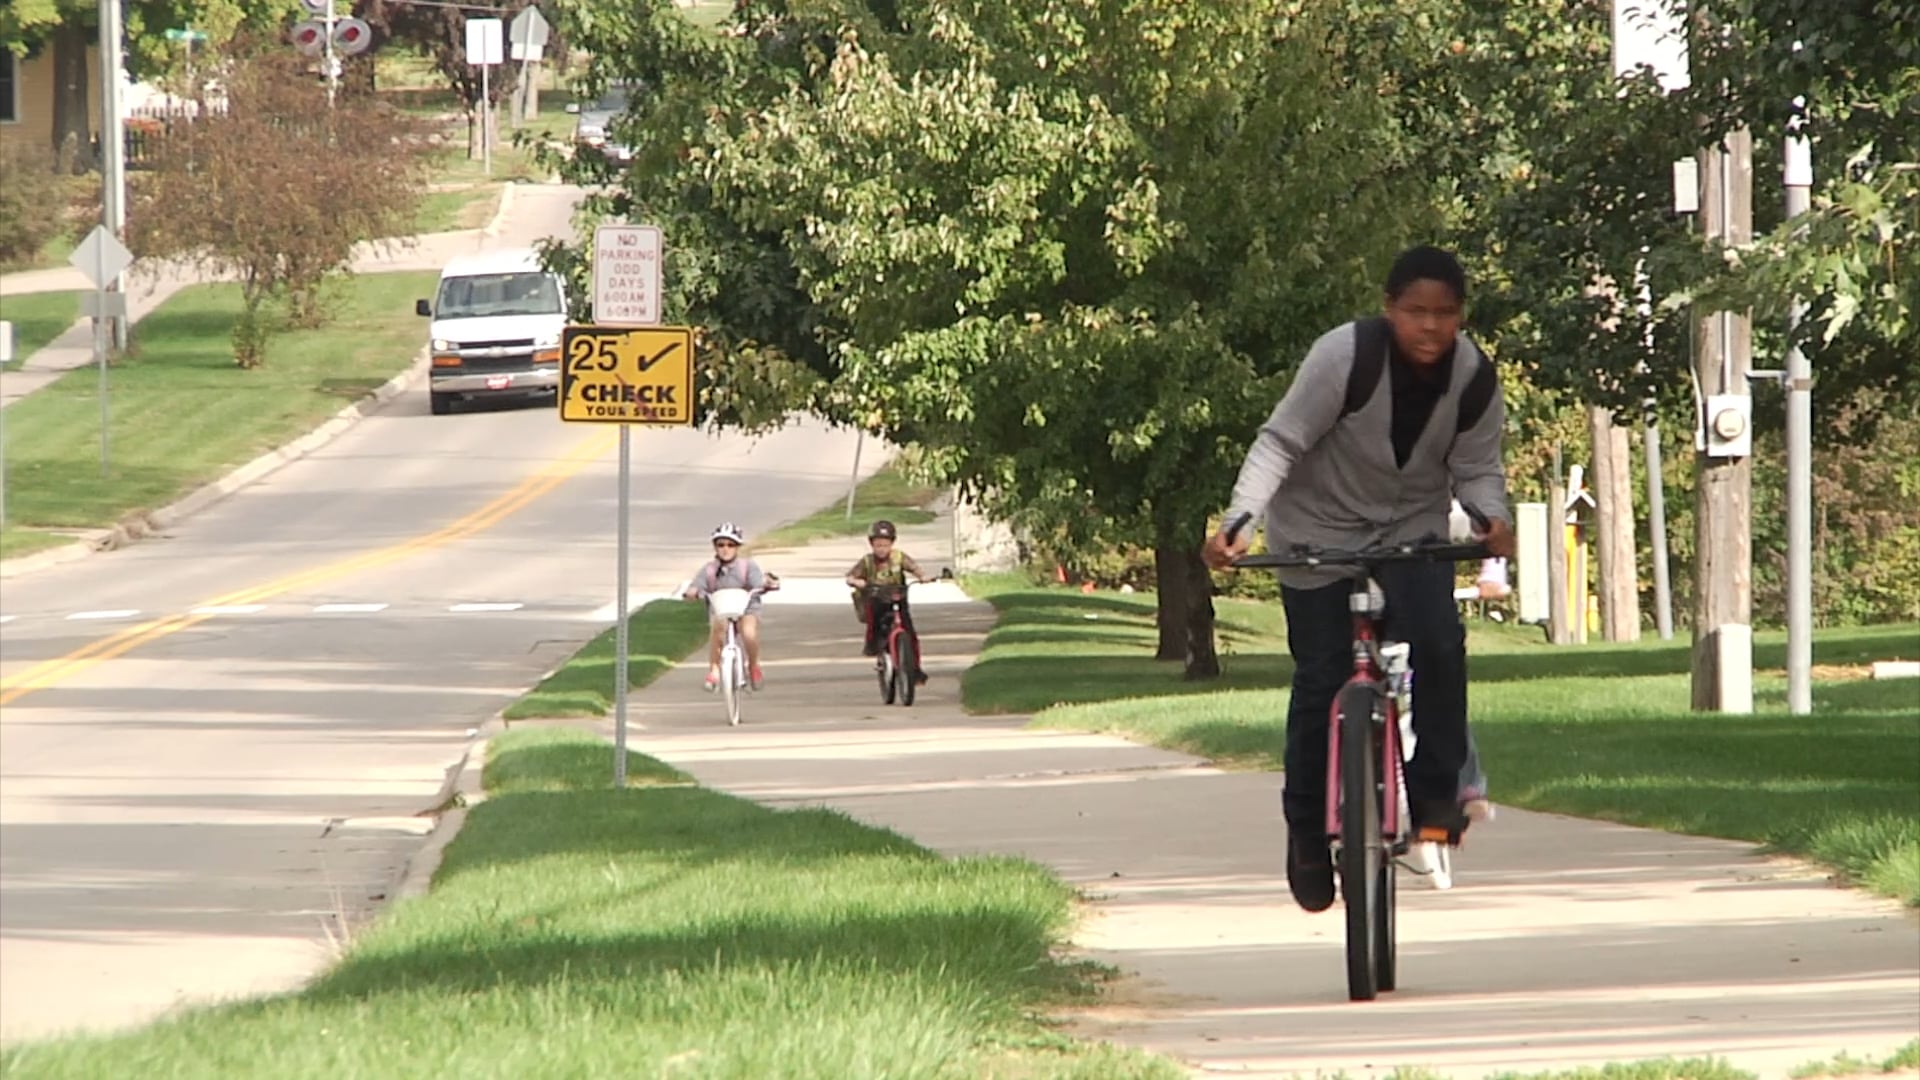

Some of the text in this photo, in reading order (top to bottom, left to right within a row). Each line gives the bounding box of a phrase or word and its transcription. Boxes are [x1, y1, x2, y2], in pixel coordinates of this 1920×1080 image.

[617, 234, 638, 247] NO
[601, 249, 655, 261] PARKING
[614, 263, 640, 275] ODD
[609, 277, 645, 289] DAYS
[573, 339, 618, 372] 25
[581, 384, 676, 404] CHECK
[586, 406, 677, 418] YOUR SPEED
